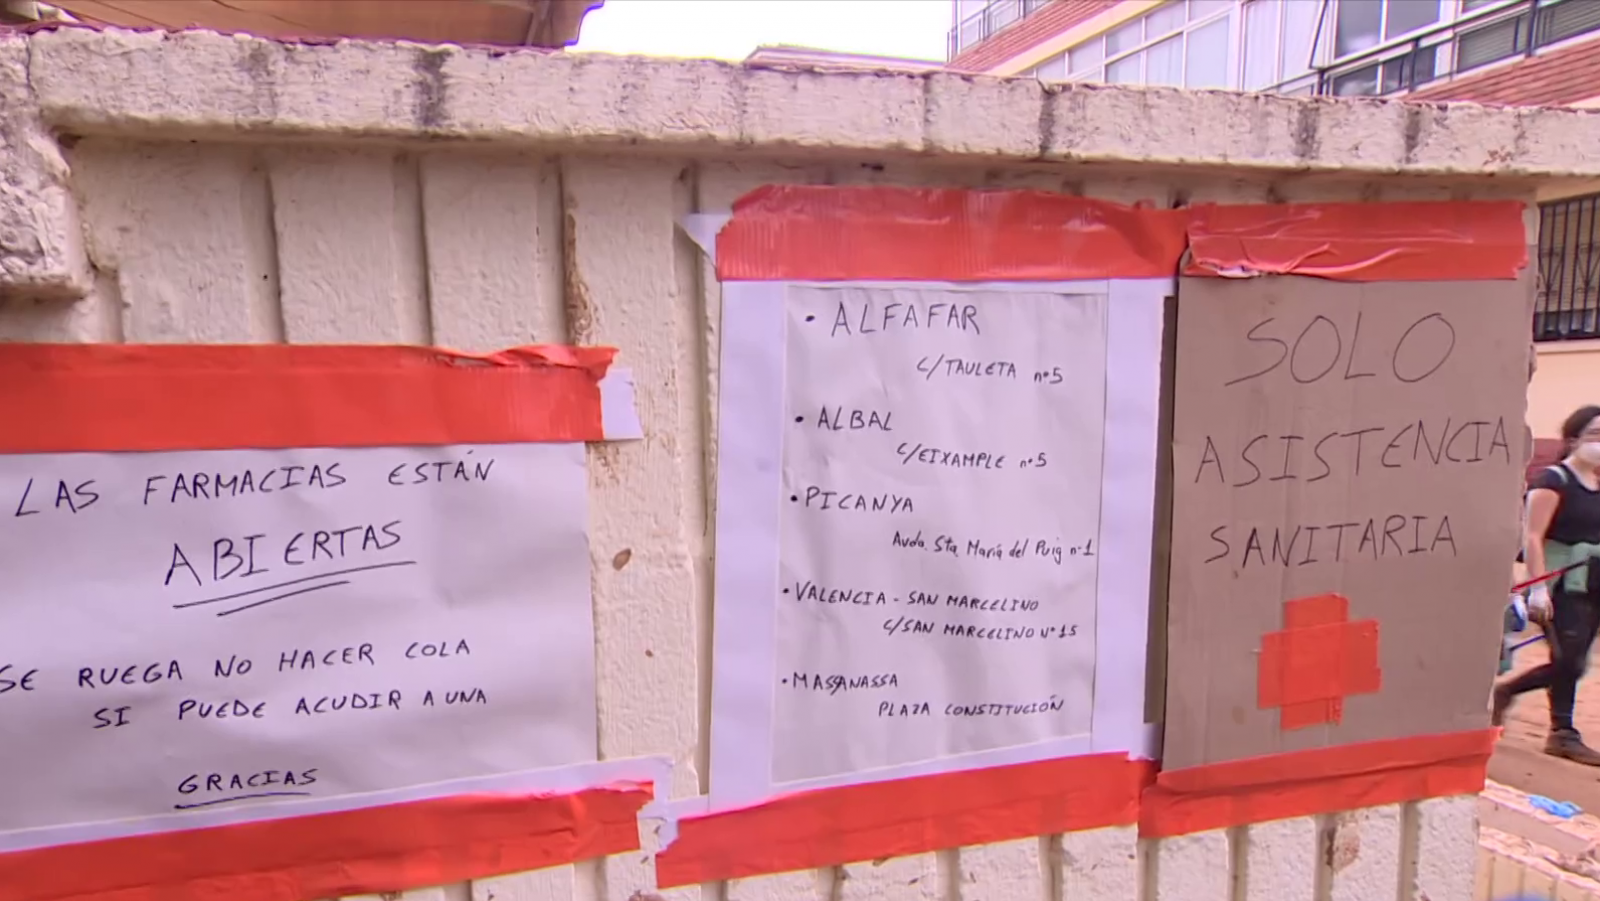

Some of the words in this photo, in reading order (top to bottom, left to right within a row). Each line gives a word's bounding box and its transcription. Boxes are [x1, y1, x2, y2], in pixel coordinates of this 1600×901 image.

[831, 301, 980, 337] ALFAFAR
[1225, 311, 1455, 386] SOLO
[817, 405, 893, 431] ALBAL
[1195, 416, 1511, 487] ASISTENCIA
[14, 477, 100, 518] LAS
[143, 462, 347, 506] FARMACIAS
[388, 450, 495, 484] ESTÁN
[805, 486, 914, 514] PICANYA
[164, 520, 403, 586] ABIERTAS
[1009, 539, 1026, 558] del
[1204, 515, 1457, 568] SANITARIA
[795, 581, 886, 605] VALENCIA
[907, 591, 939, 606] SAN
[946, 594, 1040, 612] MARCELINO
[943, 622, 1034, 640] MARCELINO
[0, 664, 37, 694] SE
[77, 660, 184, 689] RUEGA
[213, 655, 253, 679] NO
[278, 643, 376, 673] HACER
[404, 638, 472, 659] COLA
[92, 705, 132, 730] SI
[178, 699, 267, 721] PUEDE
[295, 690, 403, 714] ACUDIR
[445, 689, 488, 705] UNA
[878, 701, 931, 717] PLAZA
[178, 768, 318, 795] GRACIAS
